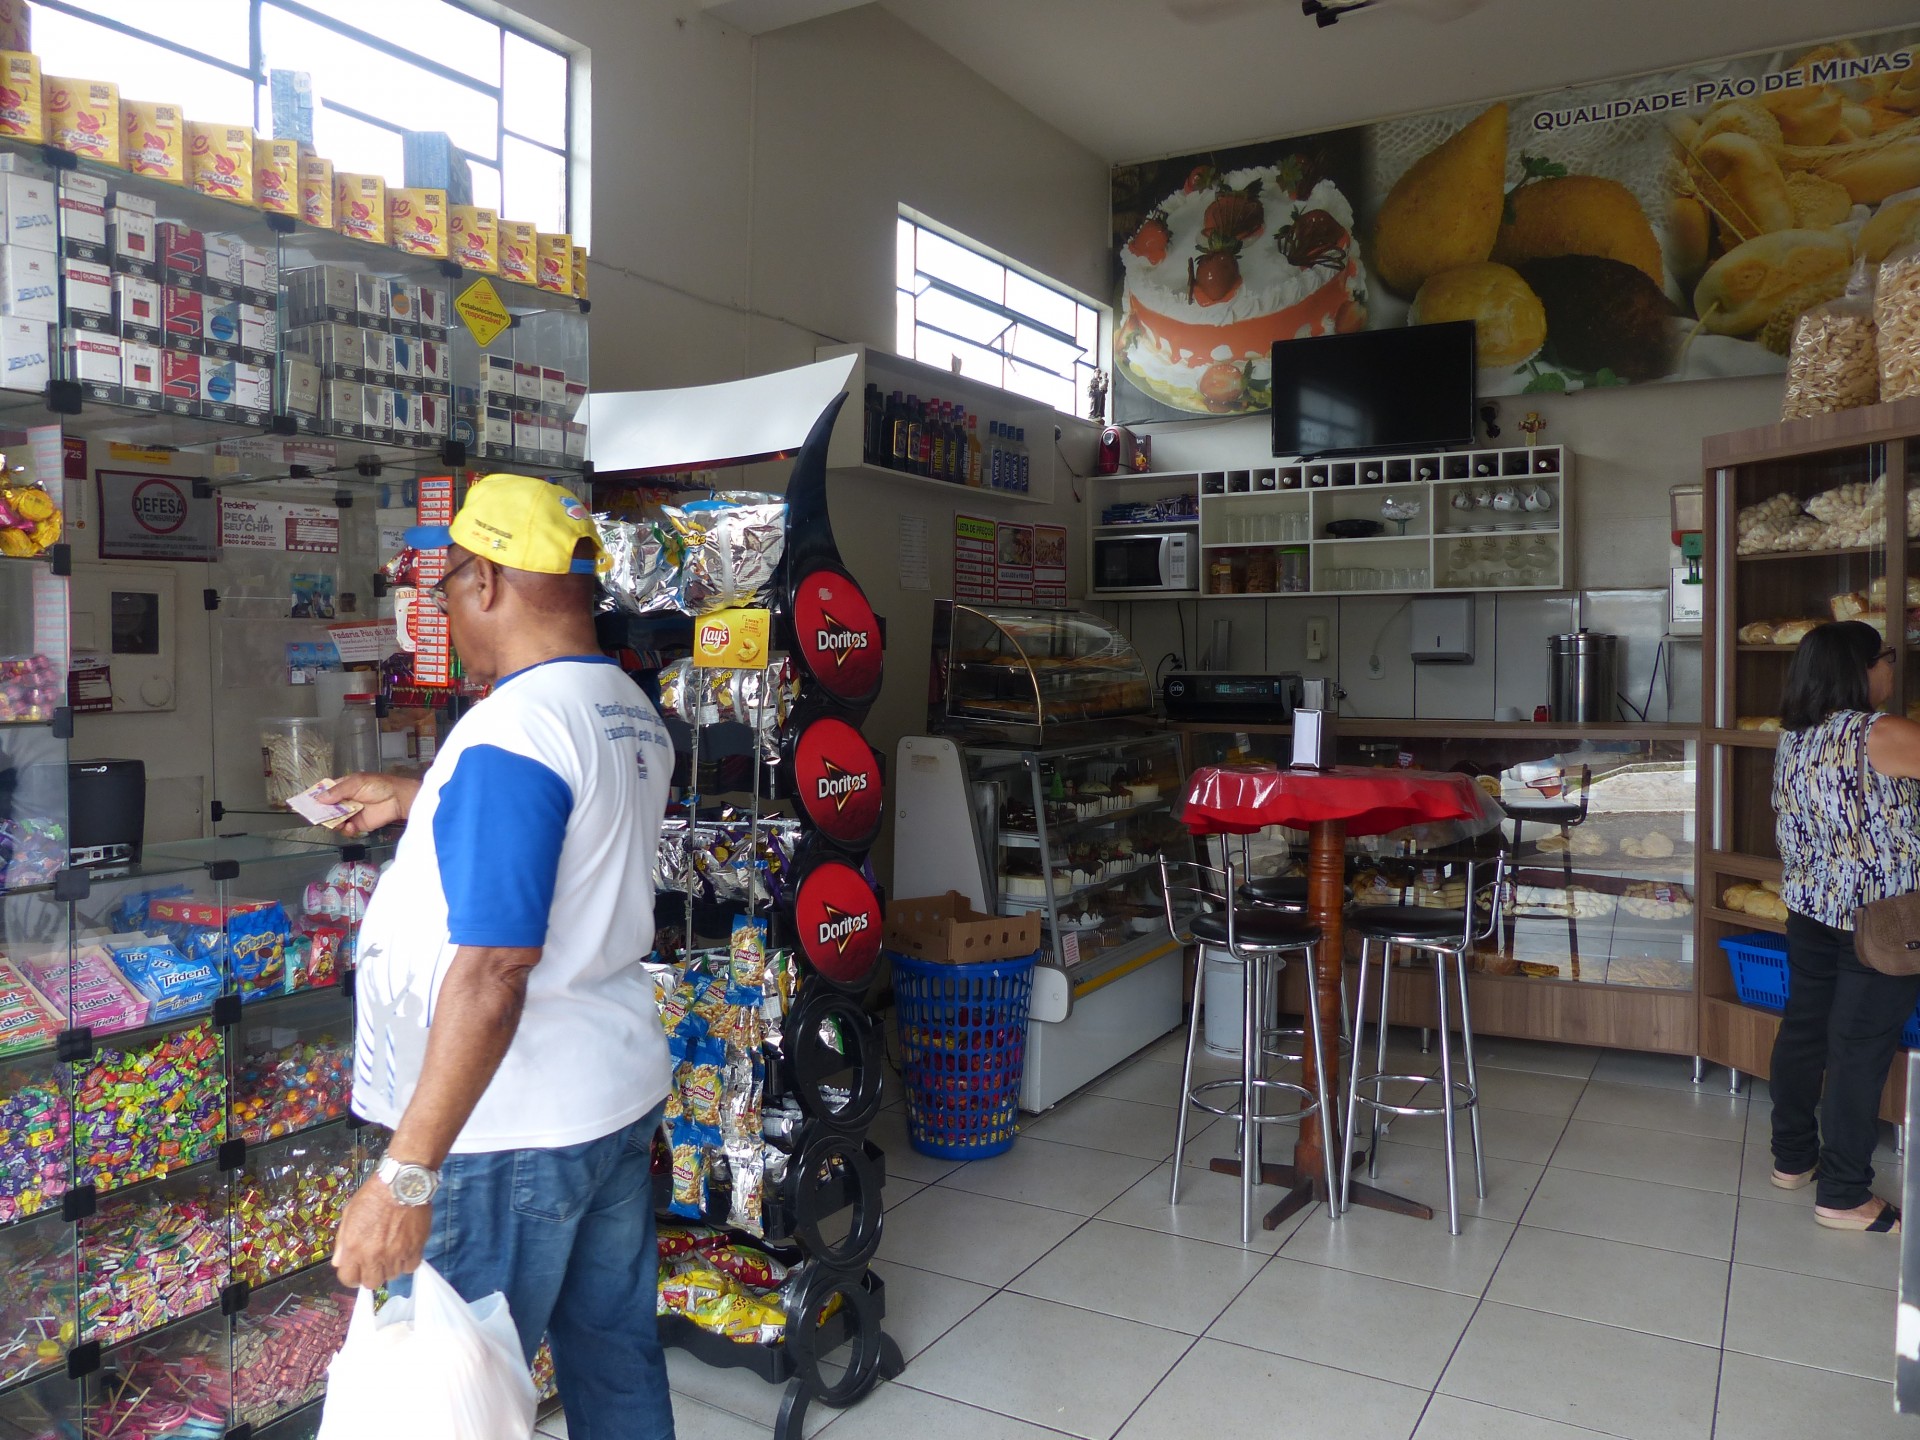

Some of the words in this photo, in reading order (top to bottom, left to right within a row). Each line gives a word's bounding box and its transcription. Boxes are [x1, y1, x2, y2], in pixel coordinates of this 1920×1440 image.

[1533, 90, 1687, 131] QUALIDADE
[1696, 79, 1756, 103] PÃO
[1765, 69, 1802, 91] DE
[1811, 51, 1911, 84] MINAS
[134, 497, 184, 514] DEFESA
[224, 522, 243, 531] SEU
[702, 627, 728, 648] Lay's
[817, 629, 867, 651] Doritos
[818, 772, 867, 797] Doritos
[819, 914, 868, 943] Doritos
[159, 966, 210, 988] Trident
[72, 993, 116, 1011] Trident
[171, 992, 204, 1009] Trident
[0, 1011, 34, 1030] ident
[93, 1011, 130, 1029] Trident
